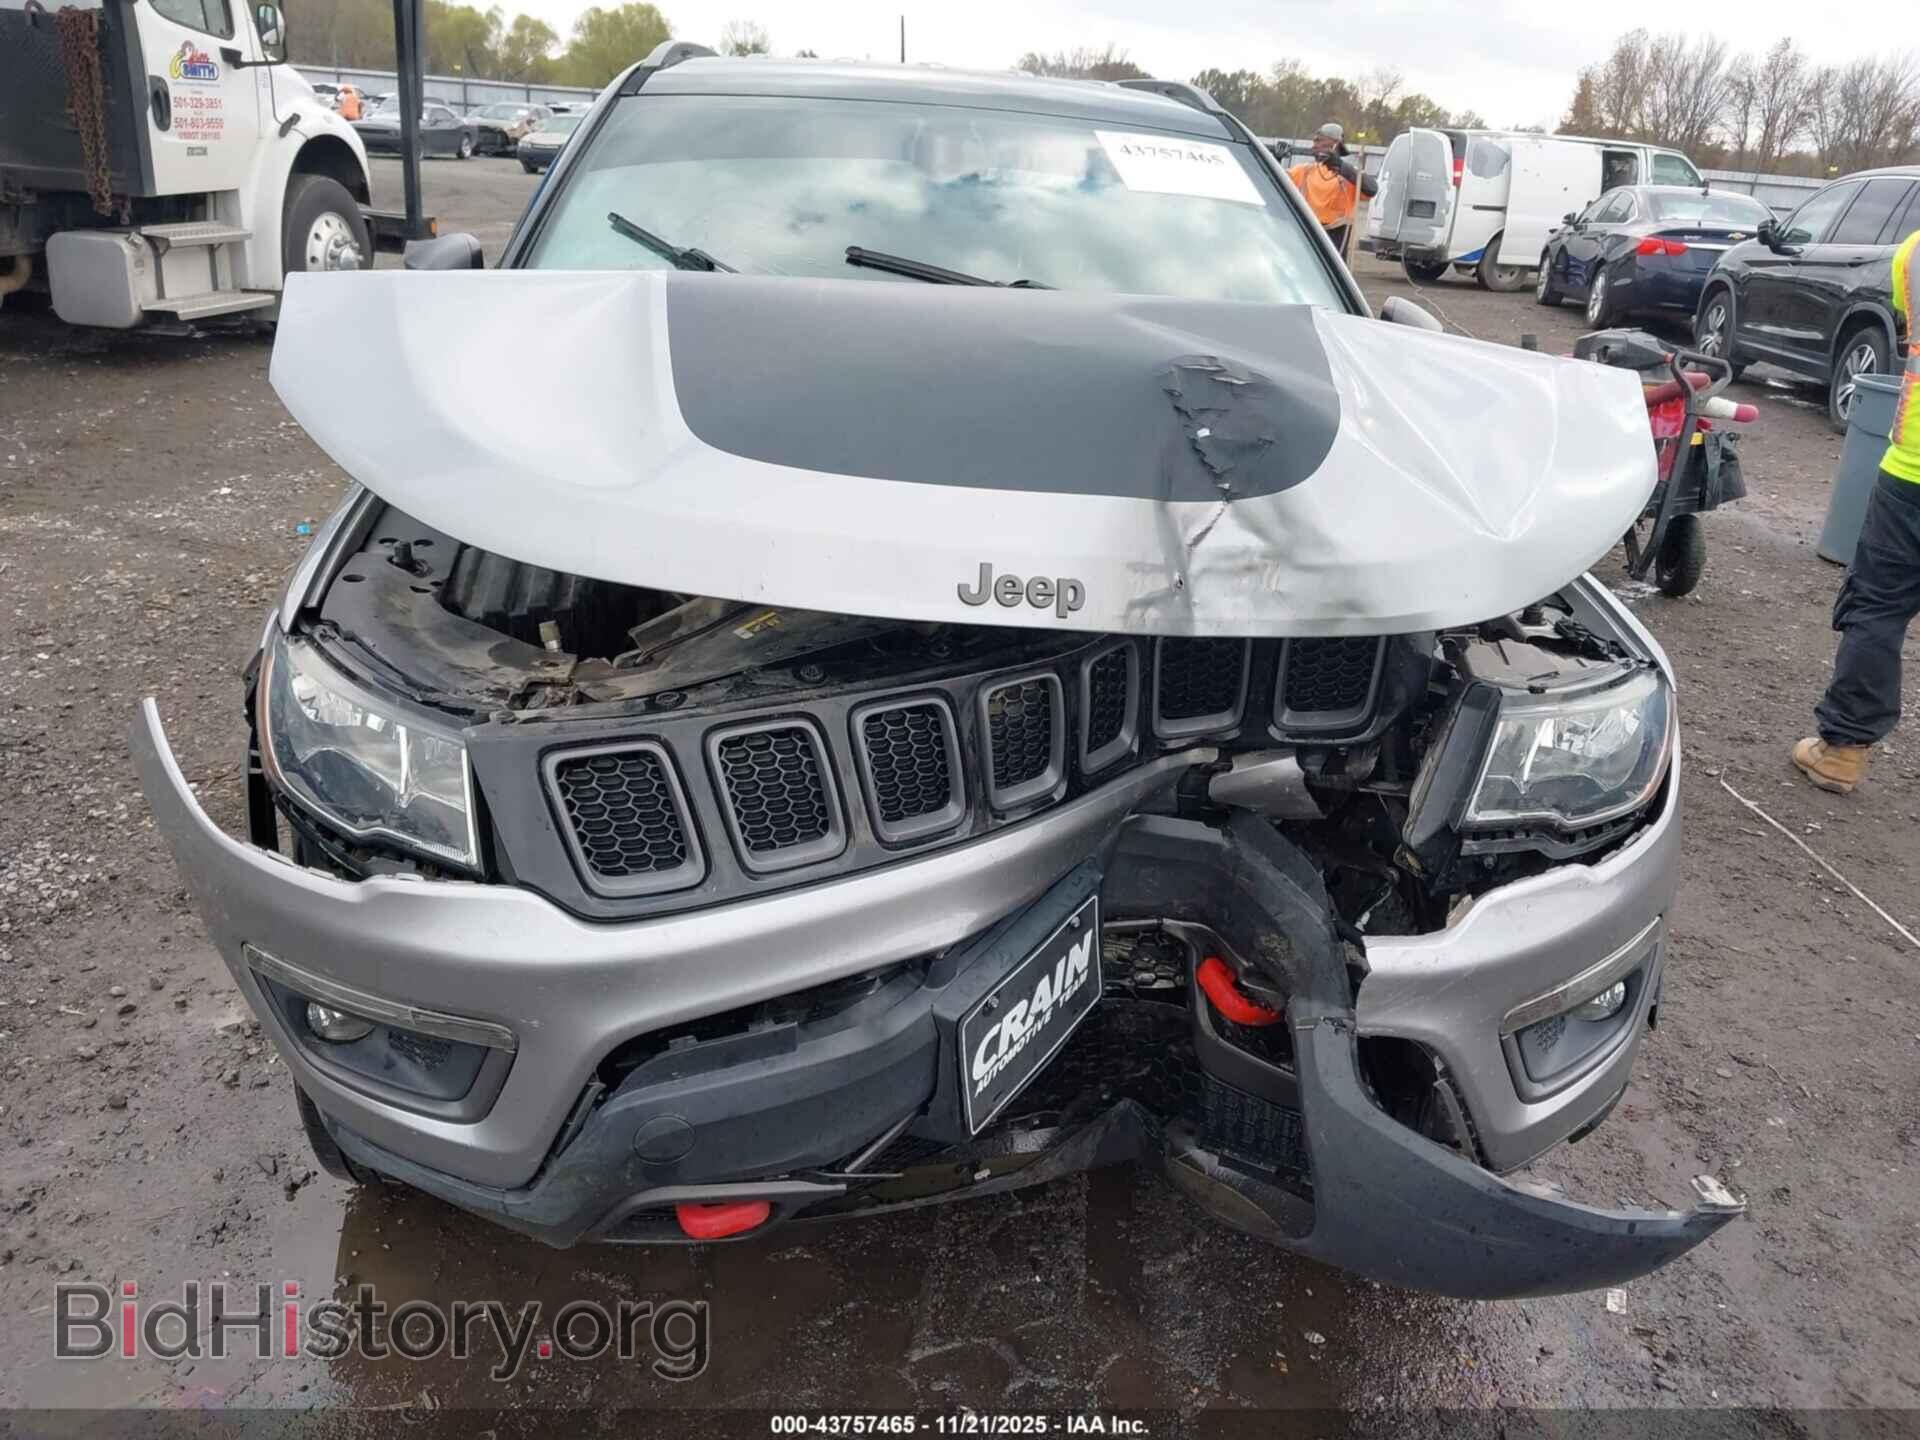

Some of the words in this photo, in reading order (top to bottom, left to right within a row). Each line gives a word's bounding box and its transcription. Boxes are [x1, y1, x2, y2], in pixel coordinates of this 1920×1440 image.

[957, 562, 1086, 619] Jeep
[972, 928, 1093, 1080] CRAIN
[974, 1007, 1053, 1098] AUTOMOTIVE
[1059, 968, 1089, 1008] TEAM
